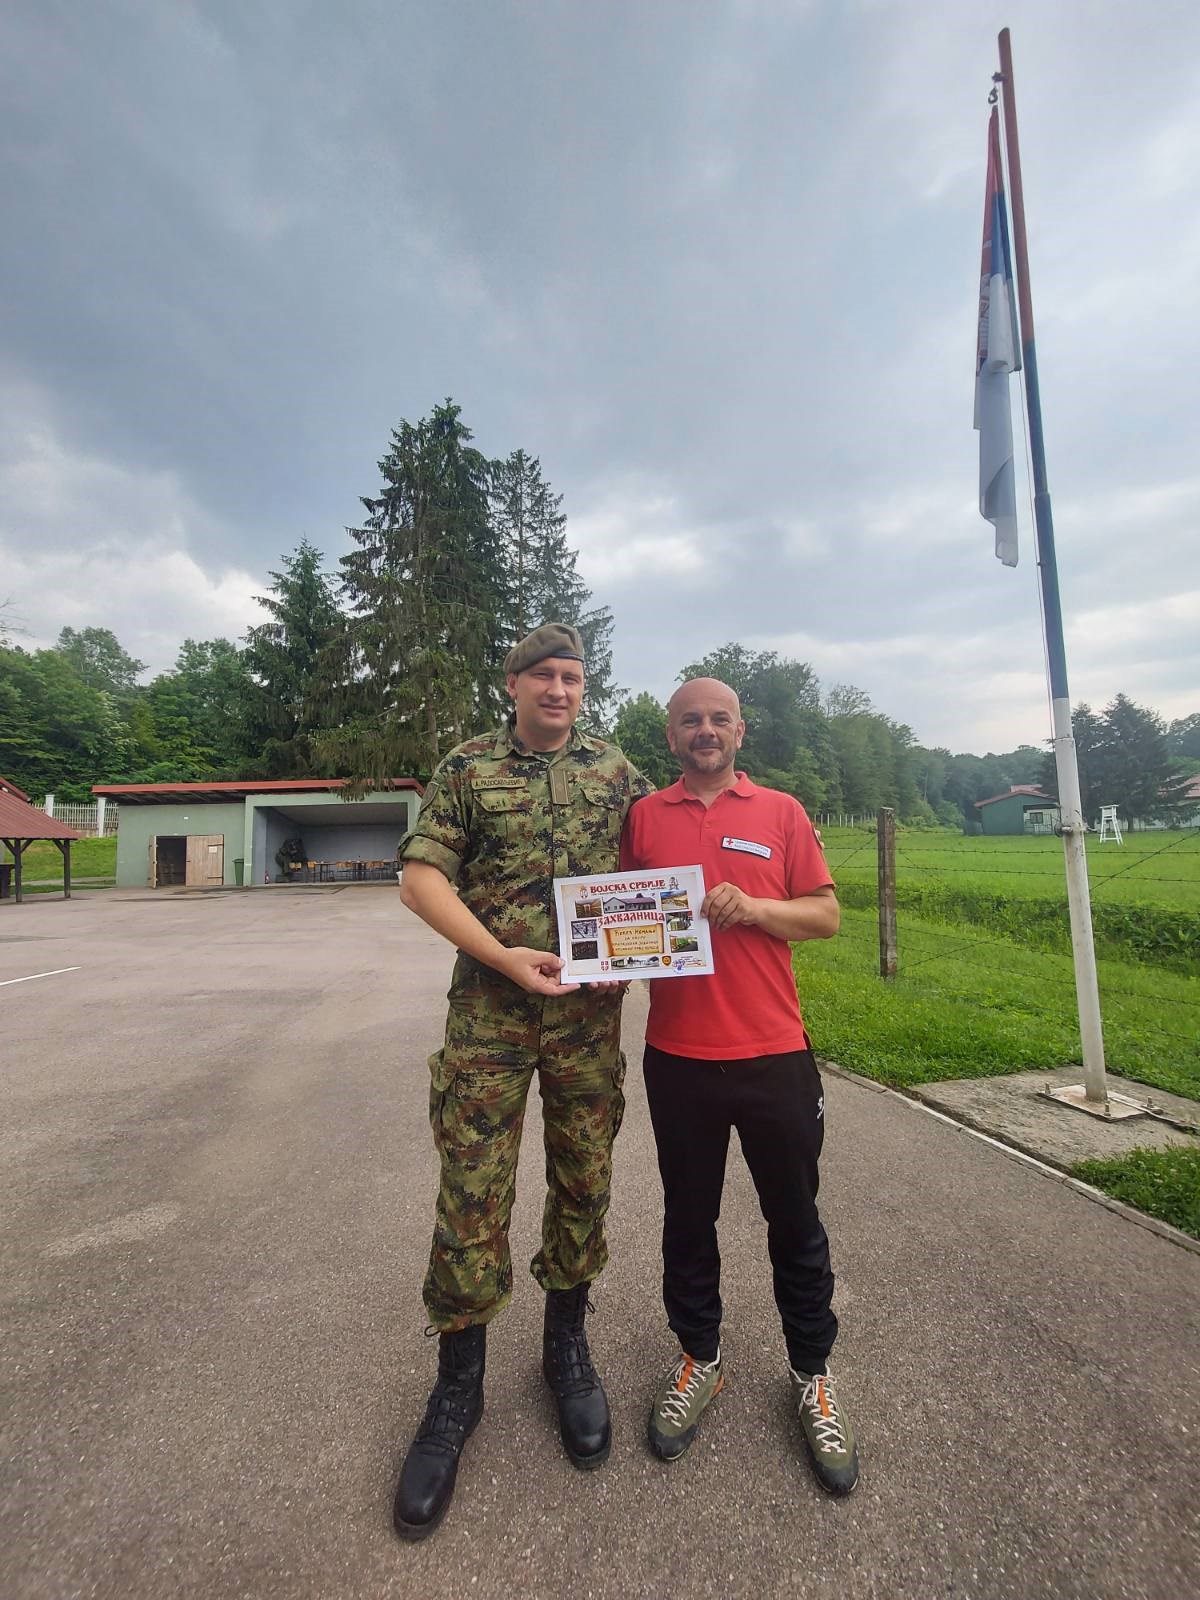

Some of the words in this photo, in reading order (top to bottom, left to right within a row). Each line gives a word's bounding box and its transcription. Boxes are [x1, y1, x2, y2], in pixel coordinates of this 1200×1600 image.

[590, 883, 626, 894] ВОЈСКА
[629, 879, 666, 890] СРБИЈЕ
[597, 911, 665, 928] ЗАХВАЛНИЦА
